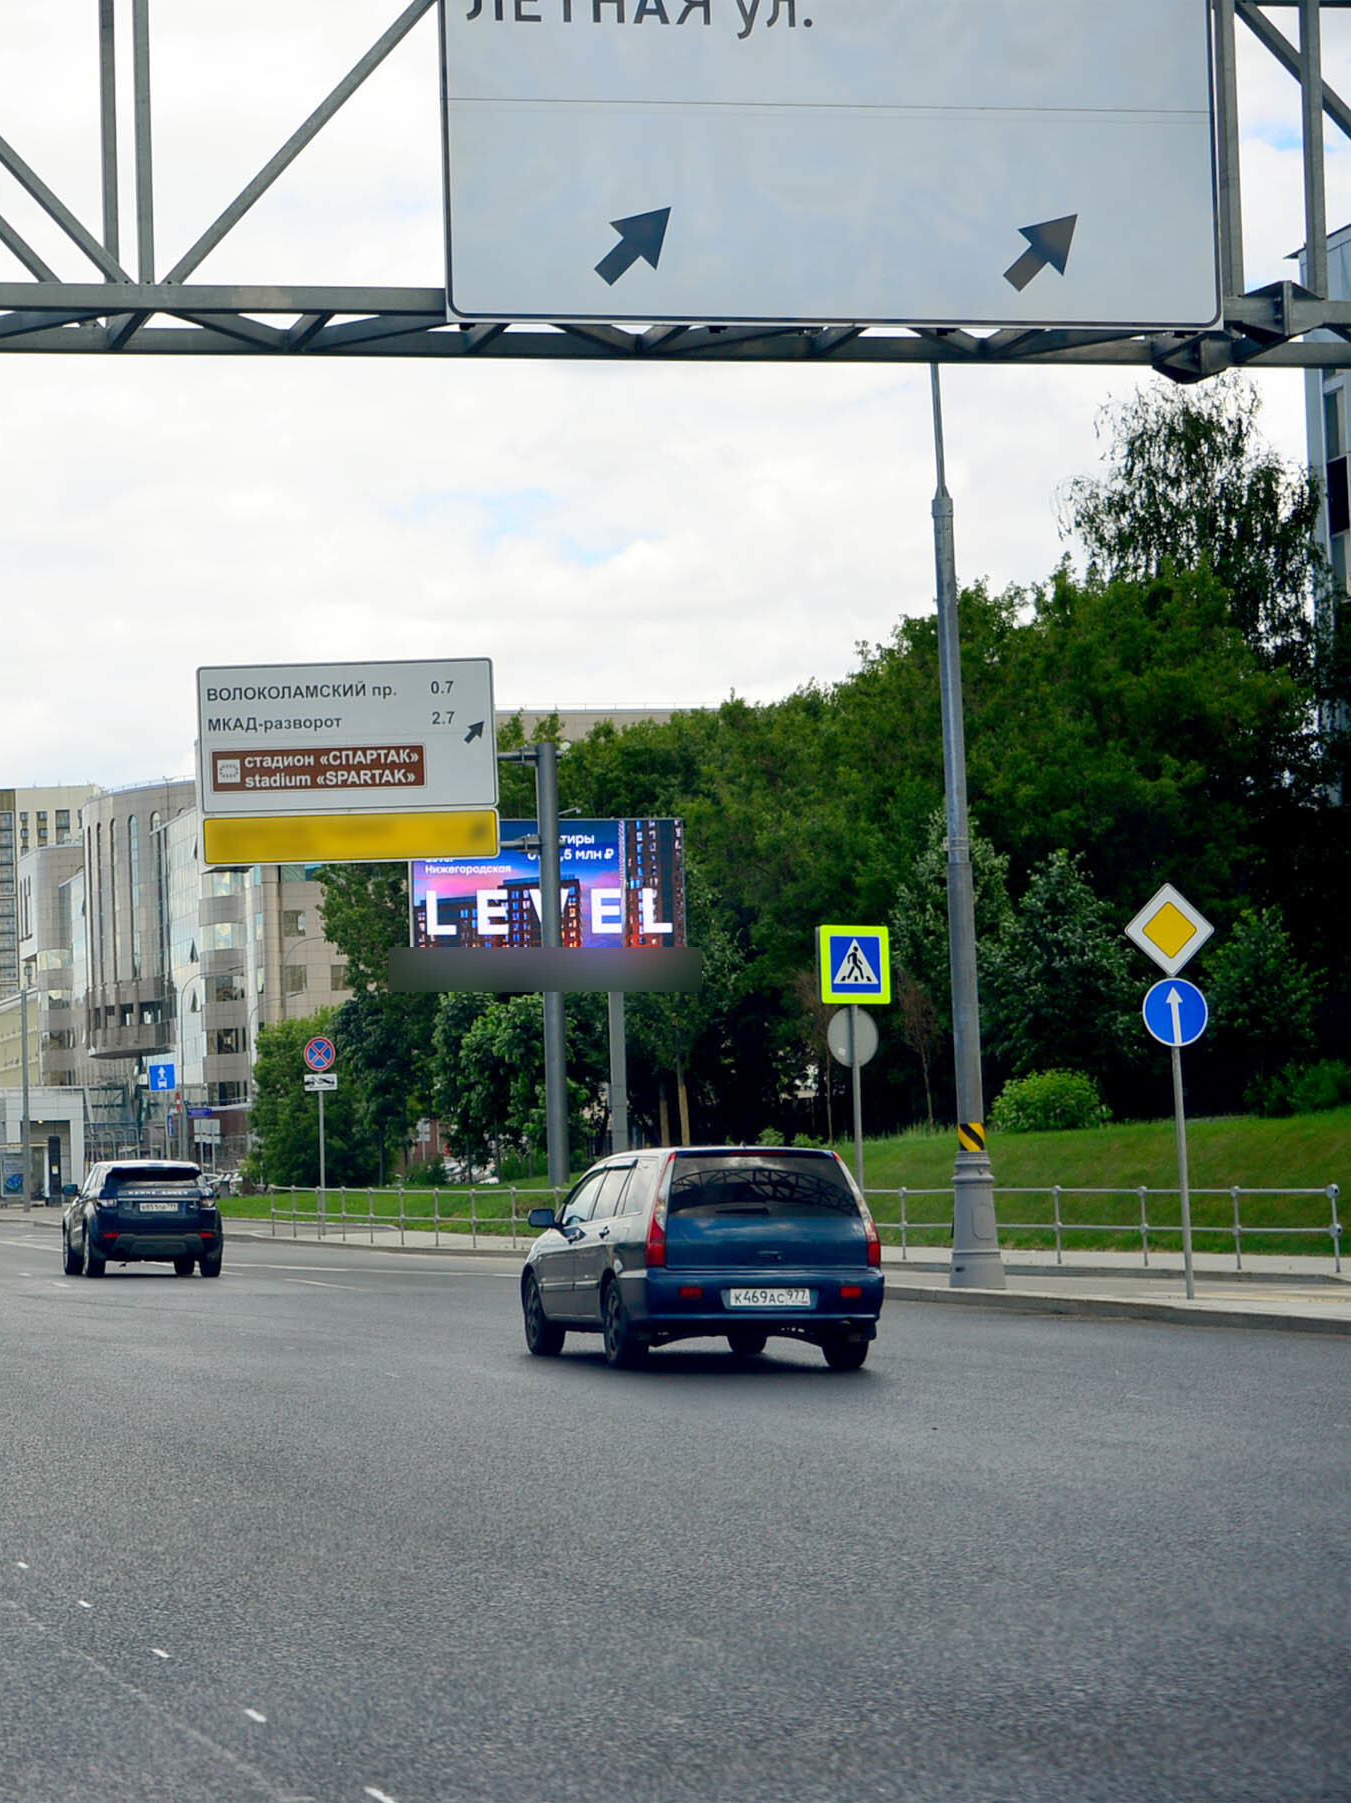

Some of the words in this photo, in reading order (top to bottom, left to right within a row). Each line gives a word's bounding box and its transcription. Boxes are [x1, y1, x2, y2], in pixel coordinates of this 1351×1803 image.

[736, 0, 813, 40] ул.
[206, 681, 366, 701] ВОЛОКОЛАМСКИЙ
[372, 686, 398, 700] пр.
[430, 680, 454, 695] 0.7
[207, 717, 342, 733] МКАД-разворот
[431, 711, 455, 725] 2.7
[244, 754, 315, 768] стадион
[320, 750, 419, 766] «СПАРТАК»
[244, 773, 311, 788] stadium
[316, 769, 416, 785] «SPARTAK»
[575, 850, 602, 860] млн
